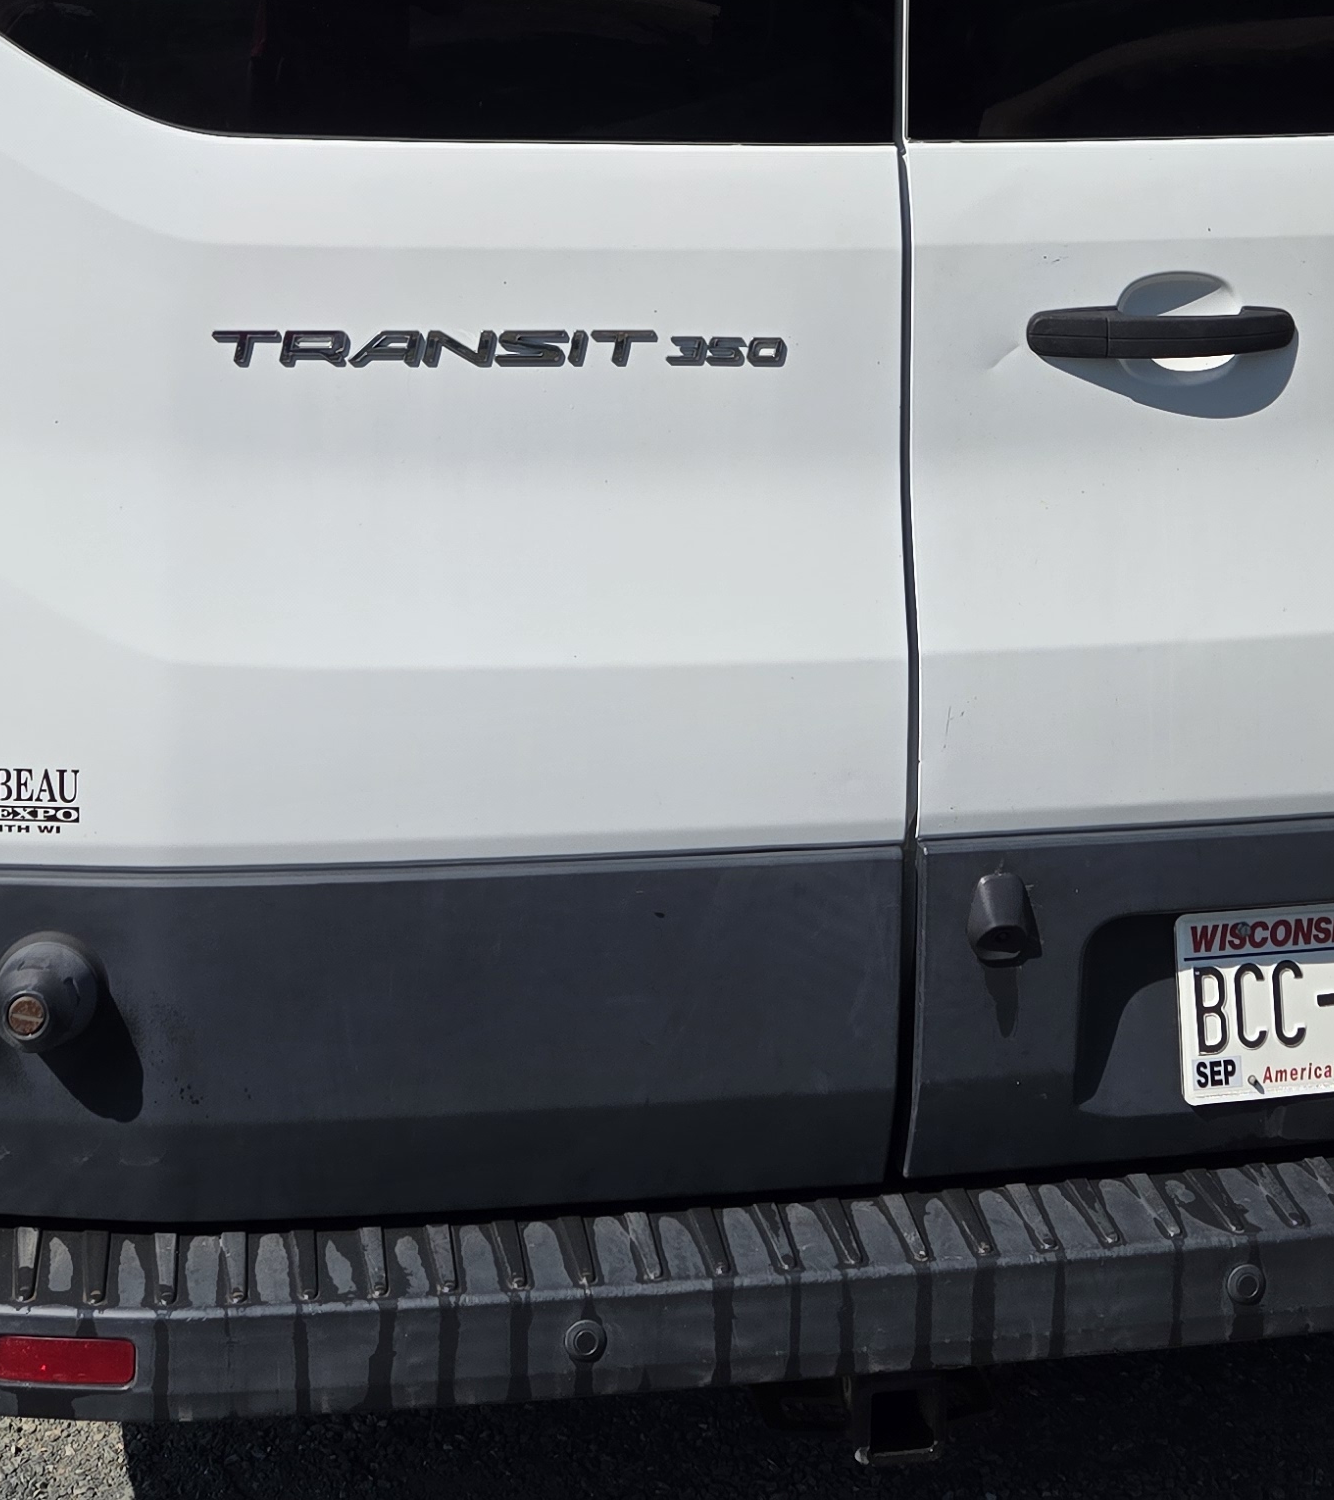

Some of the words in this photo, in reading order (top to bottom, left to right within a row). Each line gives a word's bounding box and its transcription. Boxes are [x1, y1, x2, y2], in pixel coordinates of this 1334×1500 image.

[212, 330, 658, 368] TRANSIT
[666, 336, 787, 368] 350
[38, 825, 61, 834] WI
[1196, 1059, 1237, 1088] SEP
